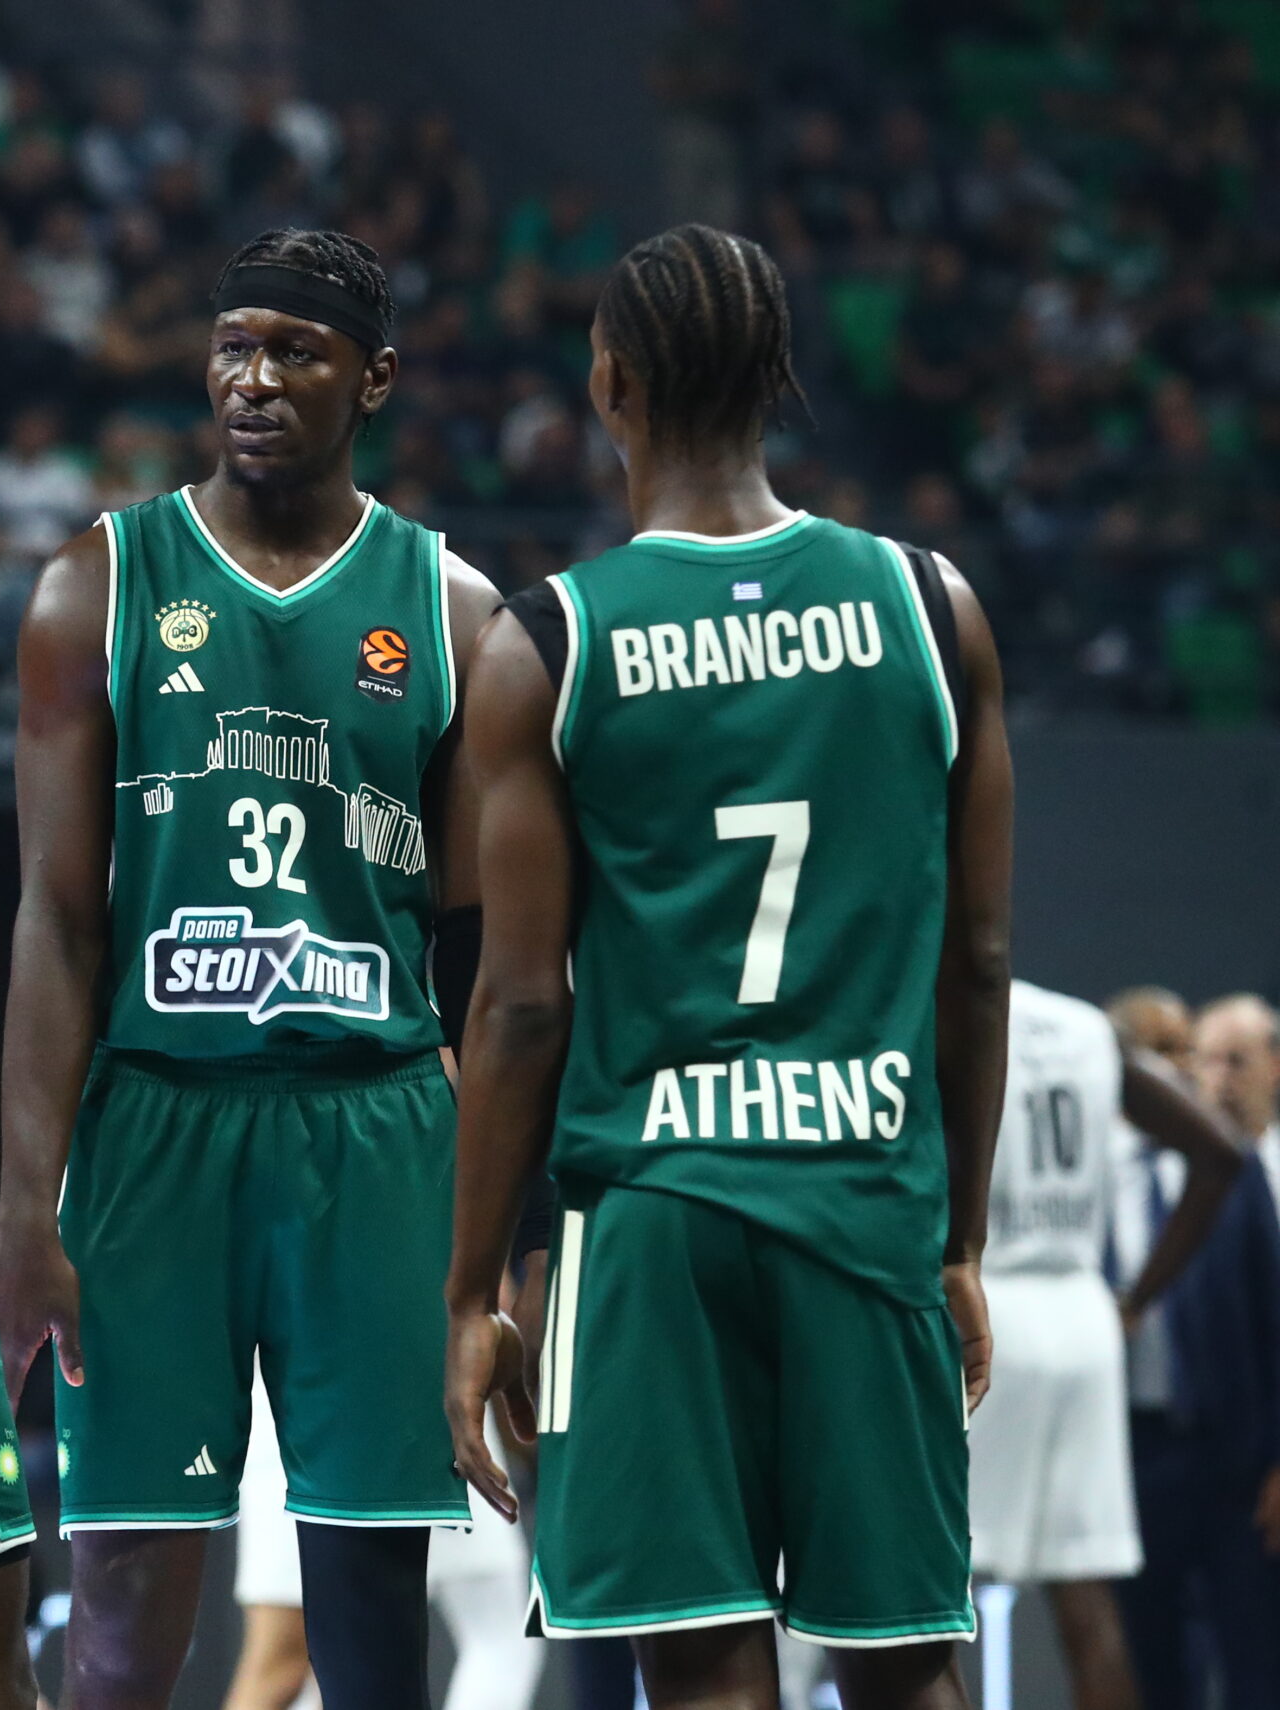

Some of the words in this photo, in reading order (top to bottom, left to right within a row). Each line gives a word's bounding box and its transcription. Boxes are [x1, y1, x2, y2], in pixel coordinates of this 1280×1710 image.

[358, 680, 403, 697] ETIHAD
[611, 601, 883, 697] BRANCOU
[227, 798, 307, 895] 32
[182, 918, 239, 942] pame
[714, 800, 810, 1005] 7
[640, 1050, 911, 1142] ATHENS
[1025, 1083, 1083, 1177] 10
